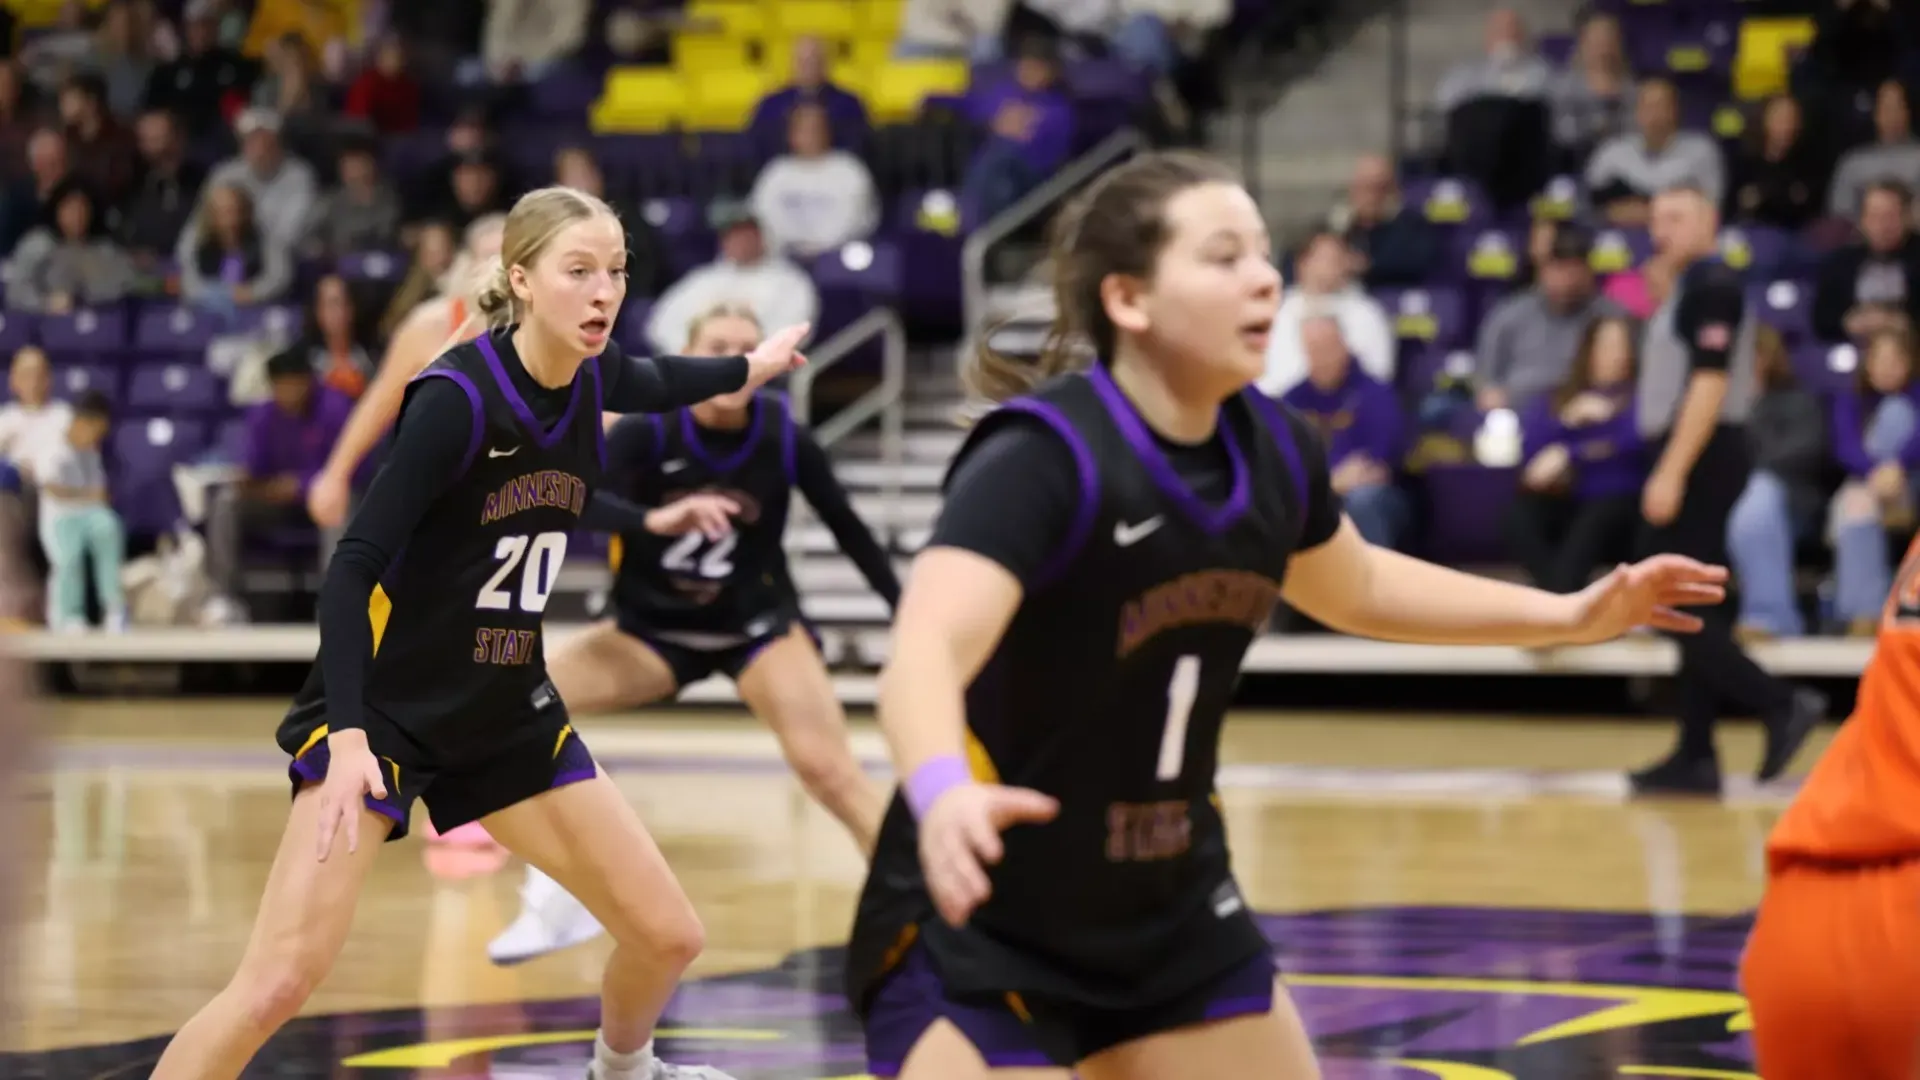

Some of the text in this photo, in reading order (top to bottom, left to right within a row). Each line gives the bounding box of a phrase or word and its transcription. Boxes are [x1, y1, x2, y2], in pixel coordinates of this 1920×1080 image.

[480, 469, 586, 525] MINNESOT
[475, 531, 567, 612] 20
[1156, 654, 1201, 781] 1
